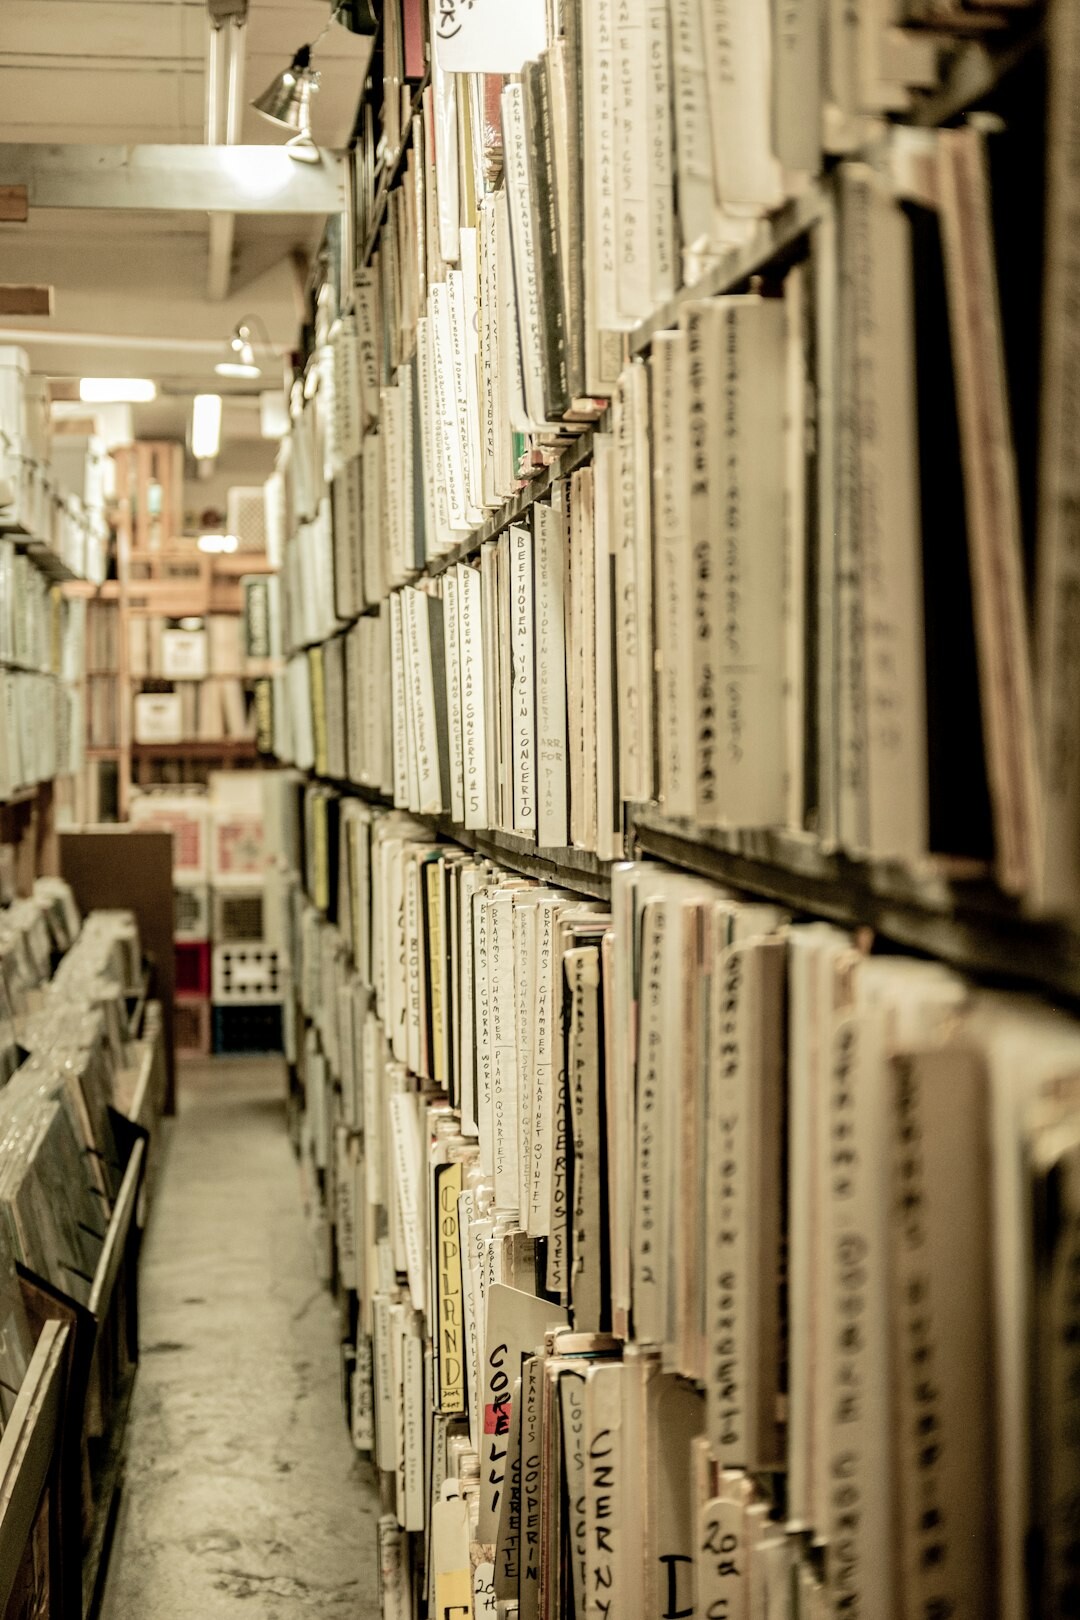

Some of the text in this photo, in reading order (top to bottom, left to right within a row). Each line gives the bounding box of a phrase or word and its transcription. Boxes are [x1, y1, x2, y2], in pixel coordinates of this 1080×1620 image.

[512, 88, 520, 123] BACH
[515, 134, 525, 178] ORGAN
[486, 377, 494, 457] KEYBOARD
[540, 509, 549, 588] BEETHOVEN
[463, 569, 471, 645] BEETHOVEN
[541, 600, 549, 654] VIOLIN
[517, 536, 531, 817] BEETHOVEN VIOLIN CONCERTO
[466, 703, 476, 775] CONCERTO
[540, 751, 562, 762] FOR
[520, 912, 528, 966] BRAHMS
[492, 908, 504, 1174] BRAHMS CHAMBER PIANO QUARTETS
[520, 979, 528, 1044] CHAMBER
[482, 1055, 491, 1104] WORKS
[521, 1055, 529, 1110] STRING
[532, 908, 551, 1213] BRAHMS CHAMBER CLARINET QUINTET
[441, 1185, 461, 1386] COPLAND
[489, 1343, 511, 1512] CORELLI
[570, 1391, 585, 1471] LOUIS
[526, 1361, 540, 1580] FRANCOIS COUPERIN
[590, 1429, 616, 1620] CZERNY
